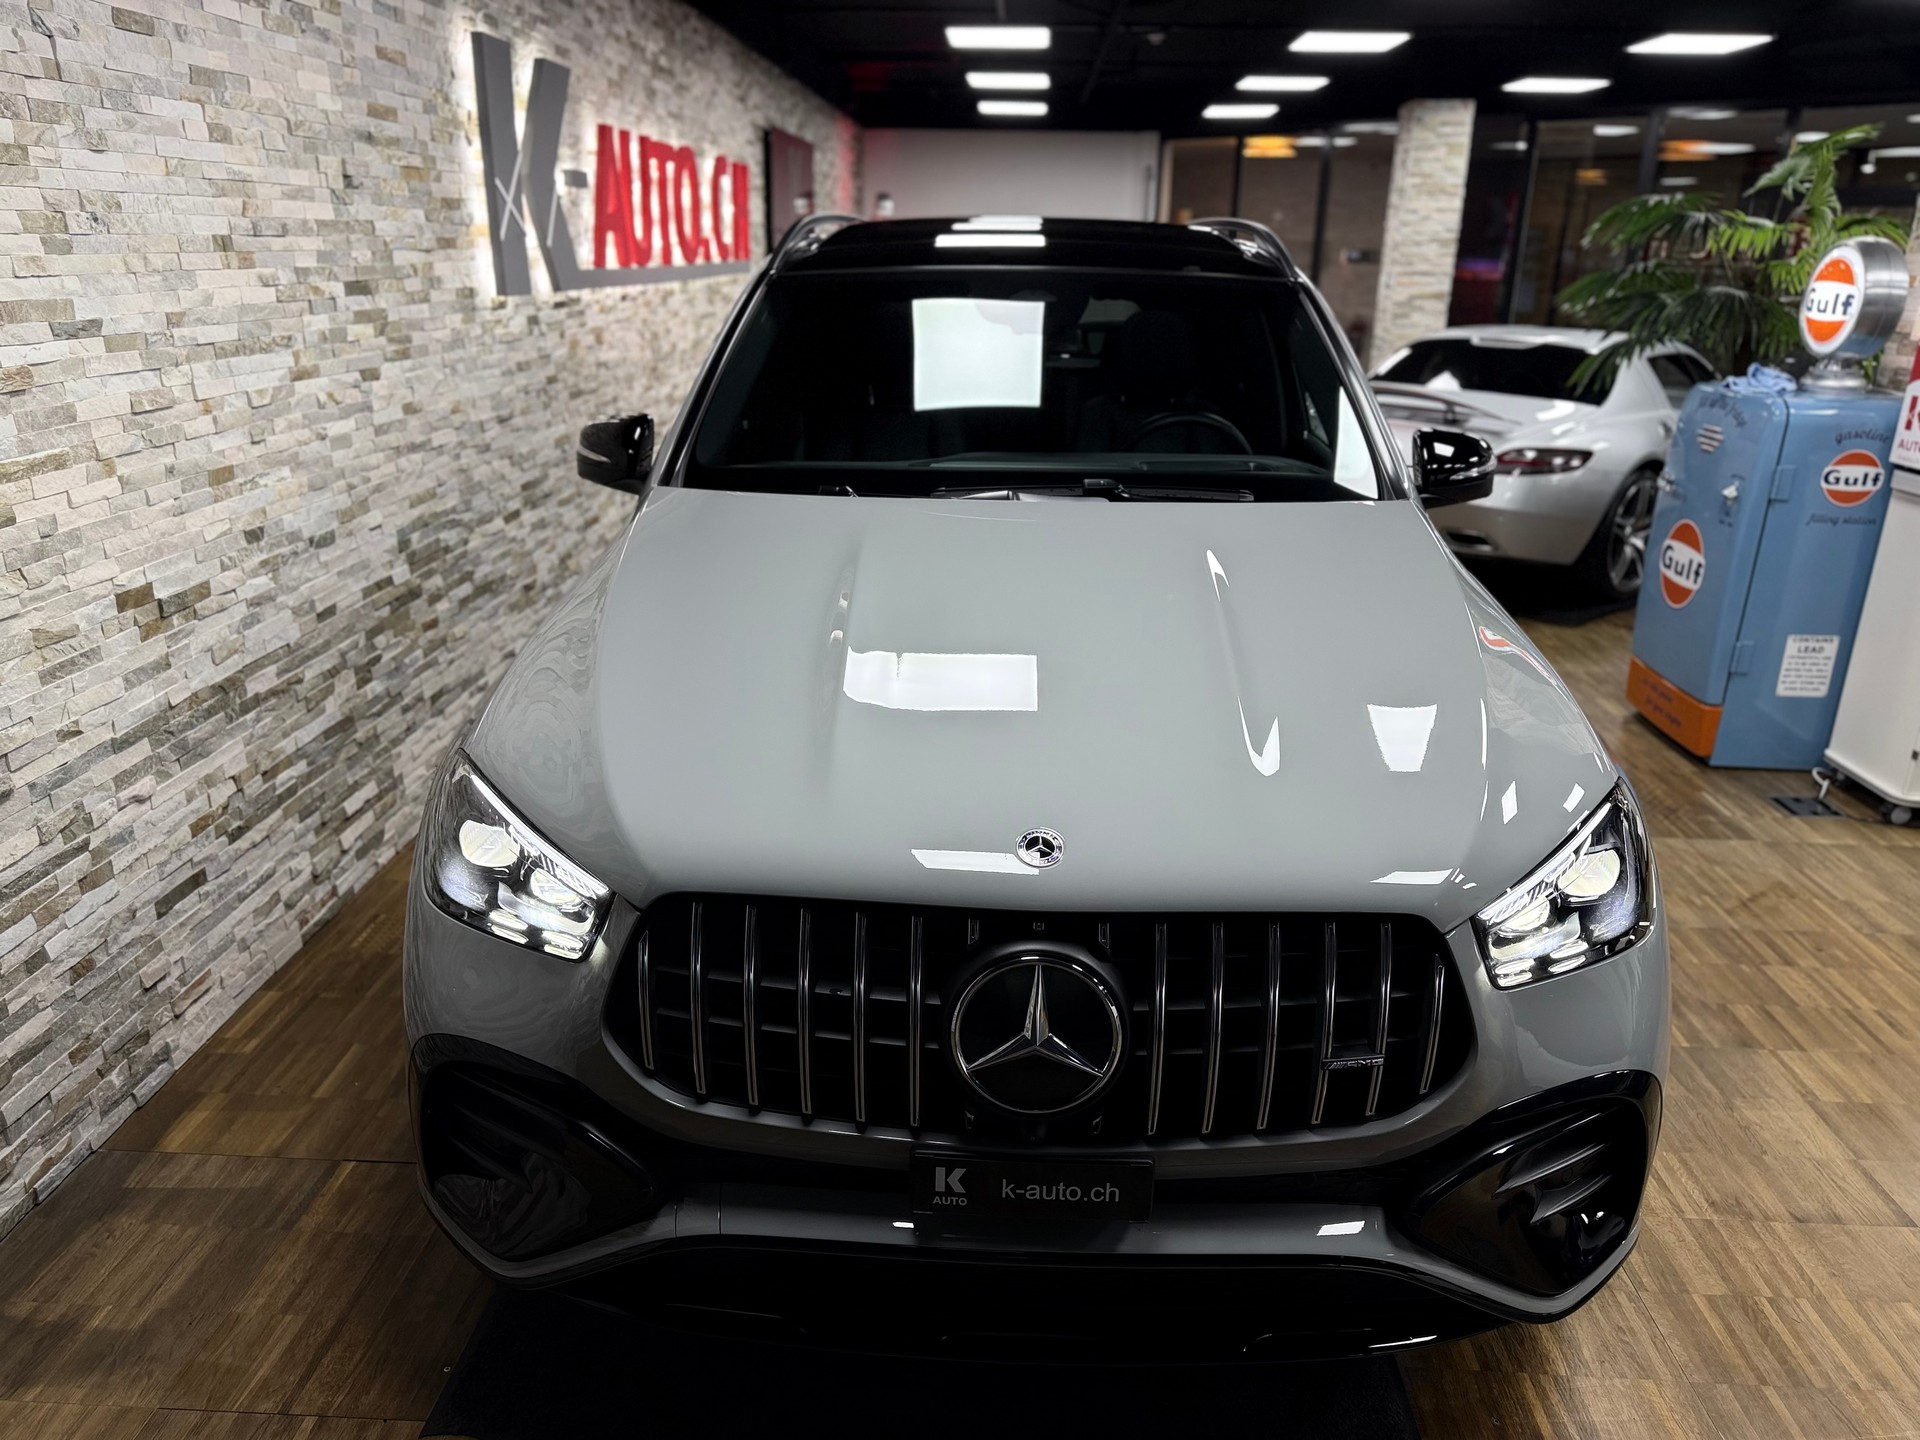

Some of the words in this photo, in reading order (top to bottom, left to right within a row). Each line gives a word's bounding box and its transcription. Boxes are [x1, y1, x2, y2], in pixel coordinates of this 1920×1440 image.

[1805, 287, 1855, 317] Gulf
[1823, 469, 1884, 487] Gulf
[1661, 544, 1705, 586] Gulf
[1797, 645, 1826, 654] LEAD
[935, 1167, 967, 1193] K
[1001, 1178, 1120, 1202] k-auto.ch
[932, 1196, 968, 1206] AUTO
